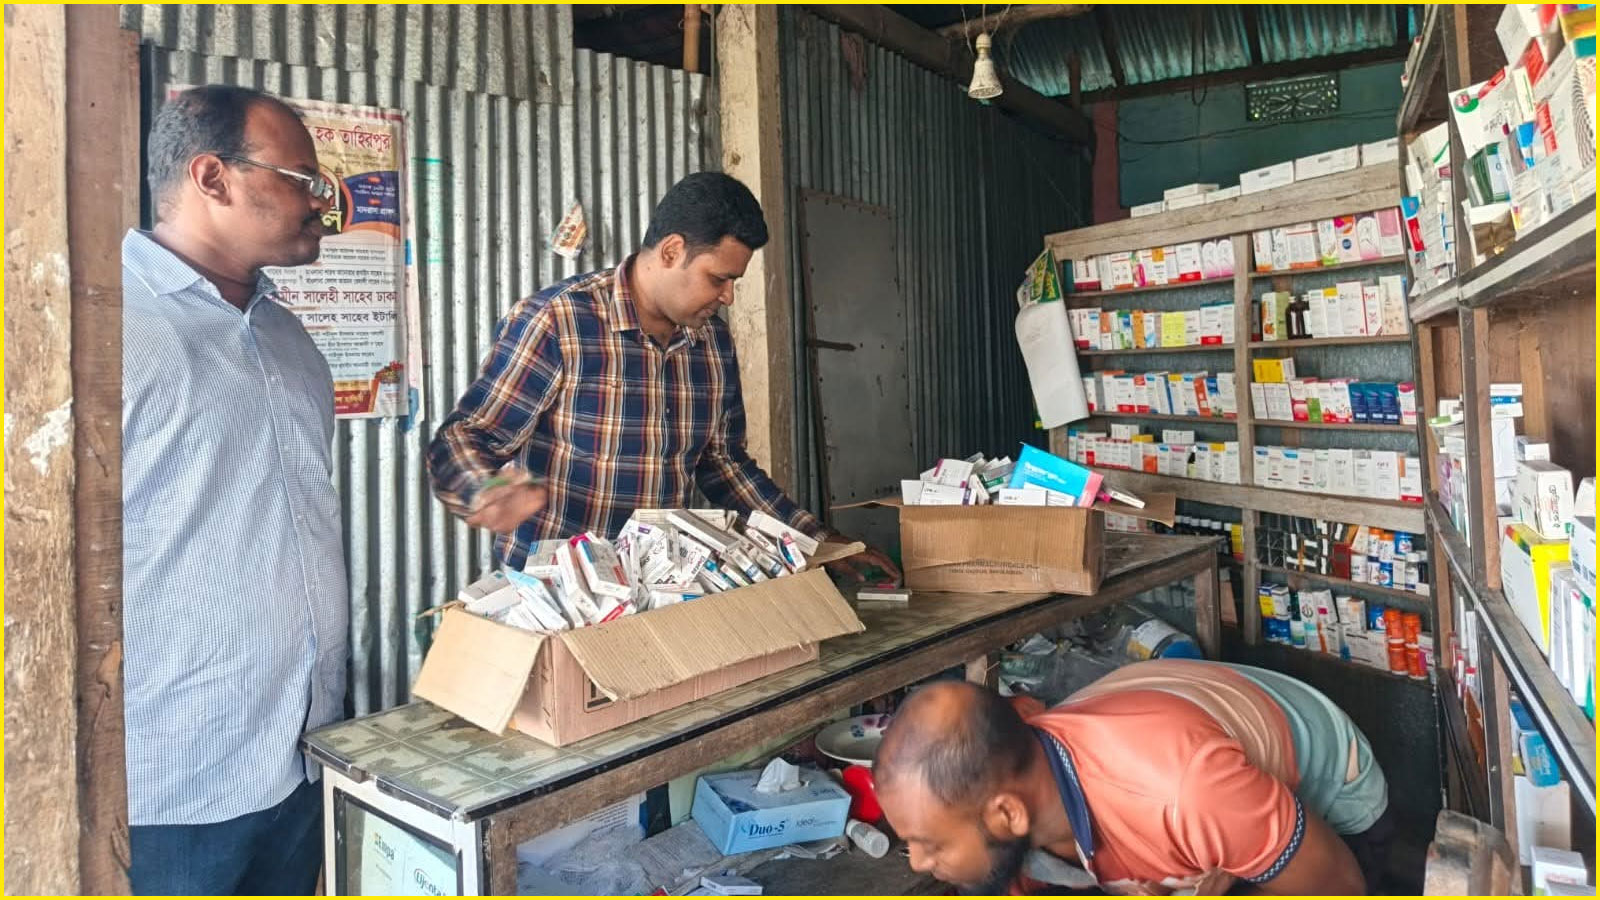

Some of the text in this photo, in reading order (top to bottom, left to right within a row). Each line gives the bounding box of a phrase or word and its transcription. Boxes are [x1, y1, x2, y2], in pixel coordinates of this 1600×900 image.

[315, 125, 392, 152] হক তাহিরপুর
[278, 285, 300, 301] মীন
[303, 285, 340, 303] সালেহী
[342, 290, 373, 305] সাহেব
[306, 313, 338, 323] সালেহ
[341, 312, 369, 323] সাহেব
[749, 820, 785, 837] Duo-5
